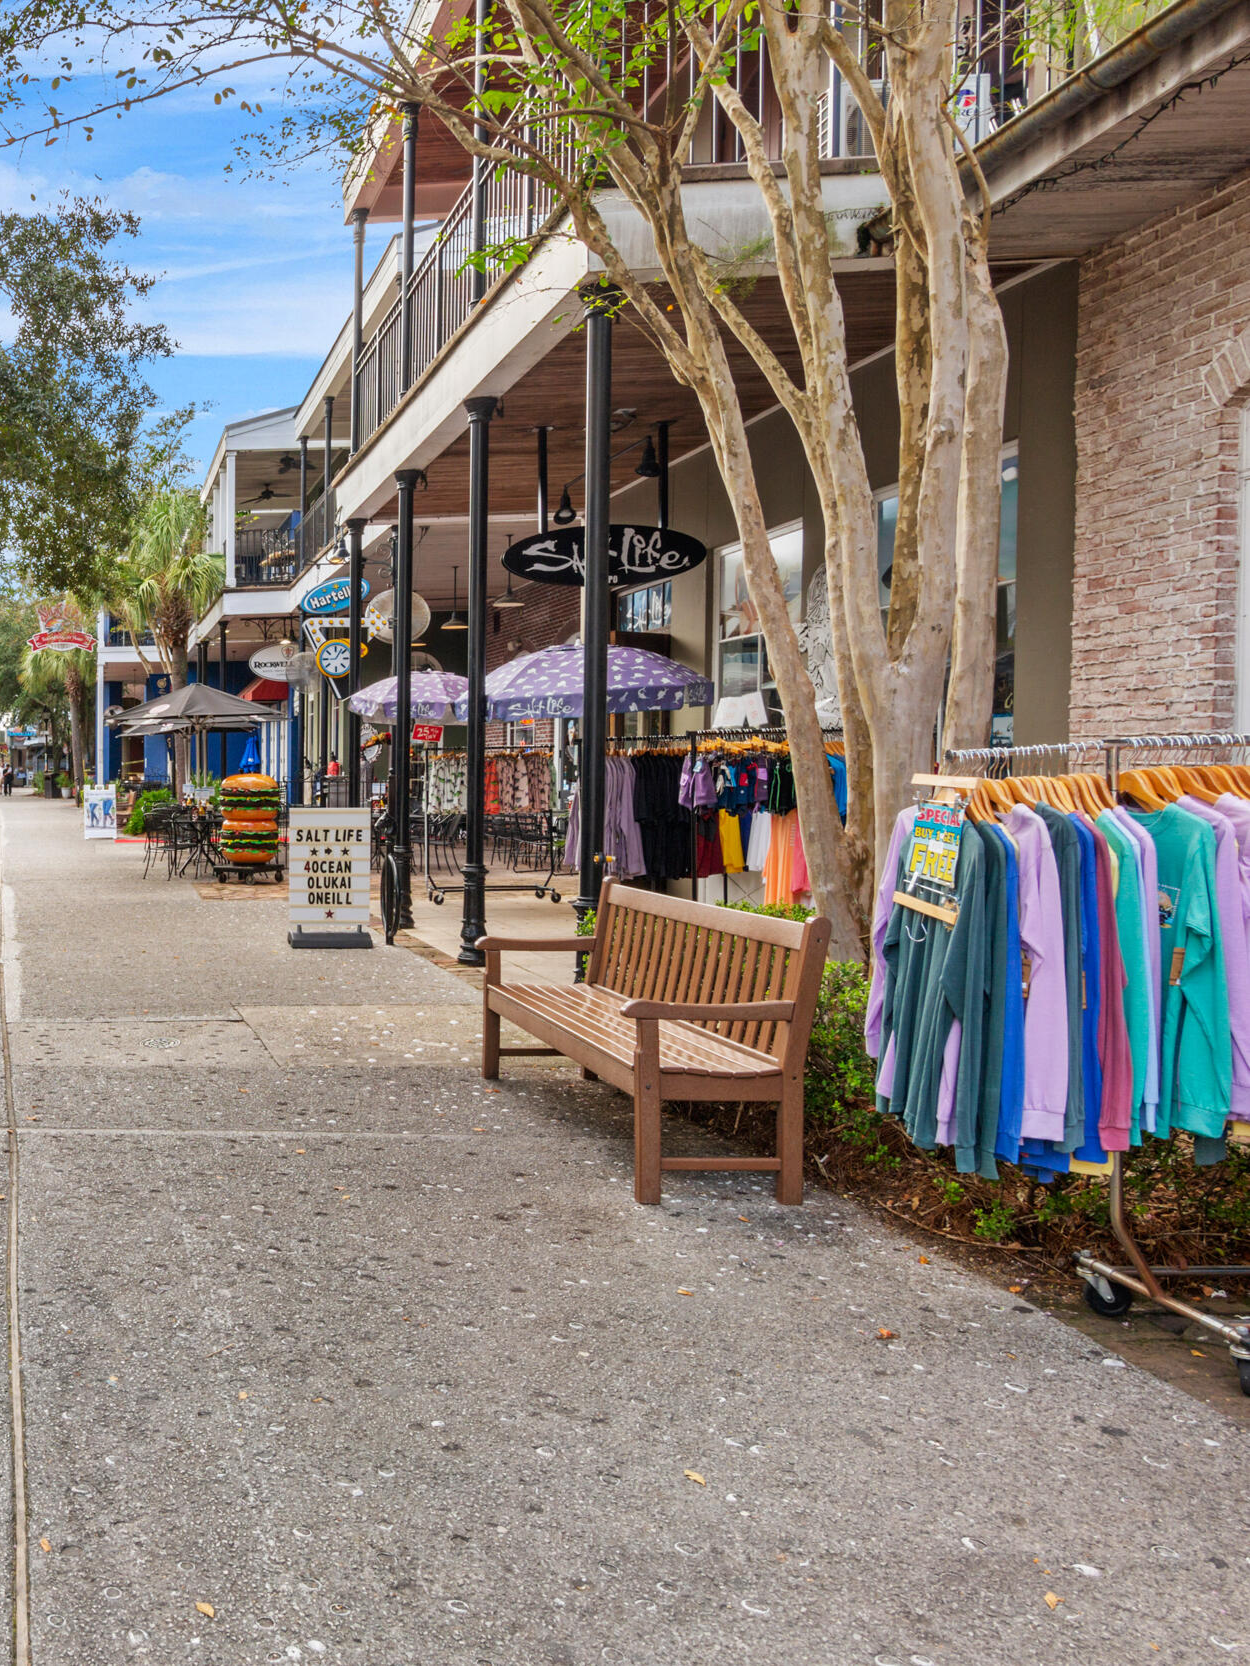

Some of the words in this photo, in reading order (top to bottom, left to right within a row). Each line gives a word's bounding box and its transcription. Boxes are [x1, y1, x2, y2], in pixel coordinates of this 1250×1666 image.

[917, 807, 960, 827] SPECIAL
[296, 829, 330, 842] SALT
[335, 829, 363, 842] LIFE
[914, 826, 934, 840] BUY
[304, 861, 352, 873] 4OCEAN
[909, 842, 957, 882] FREE
[307, 876, 352, 889] OLUKAI
[308, 892, 352, 905] ONEILL
